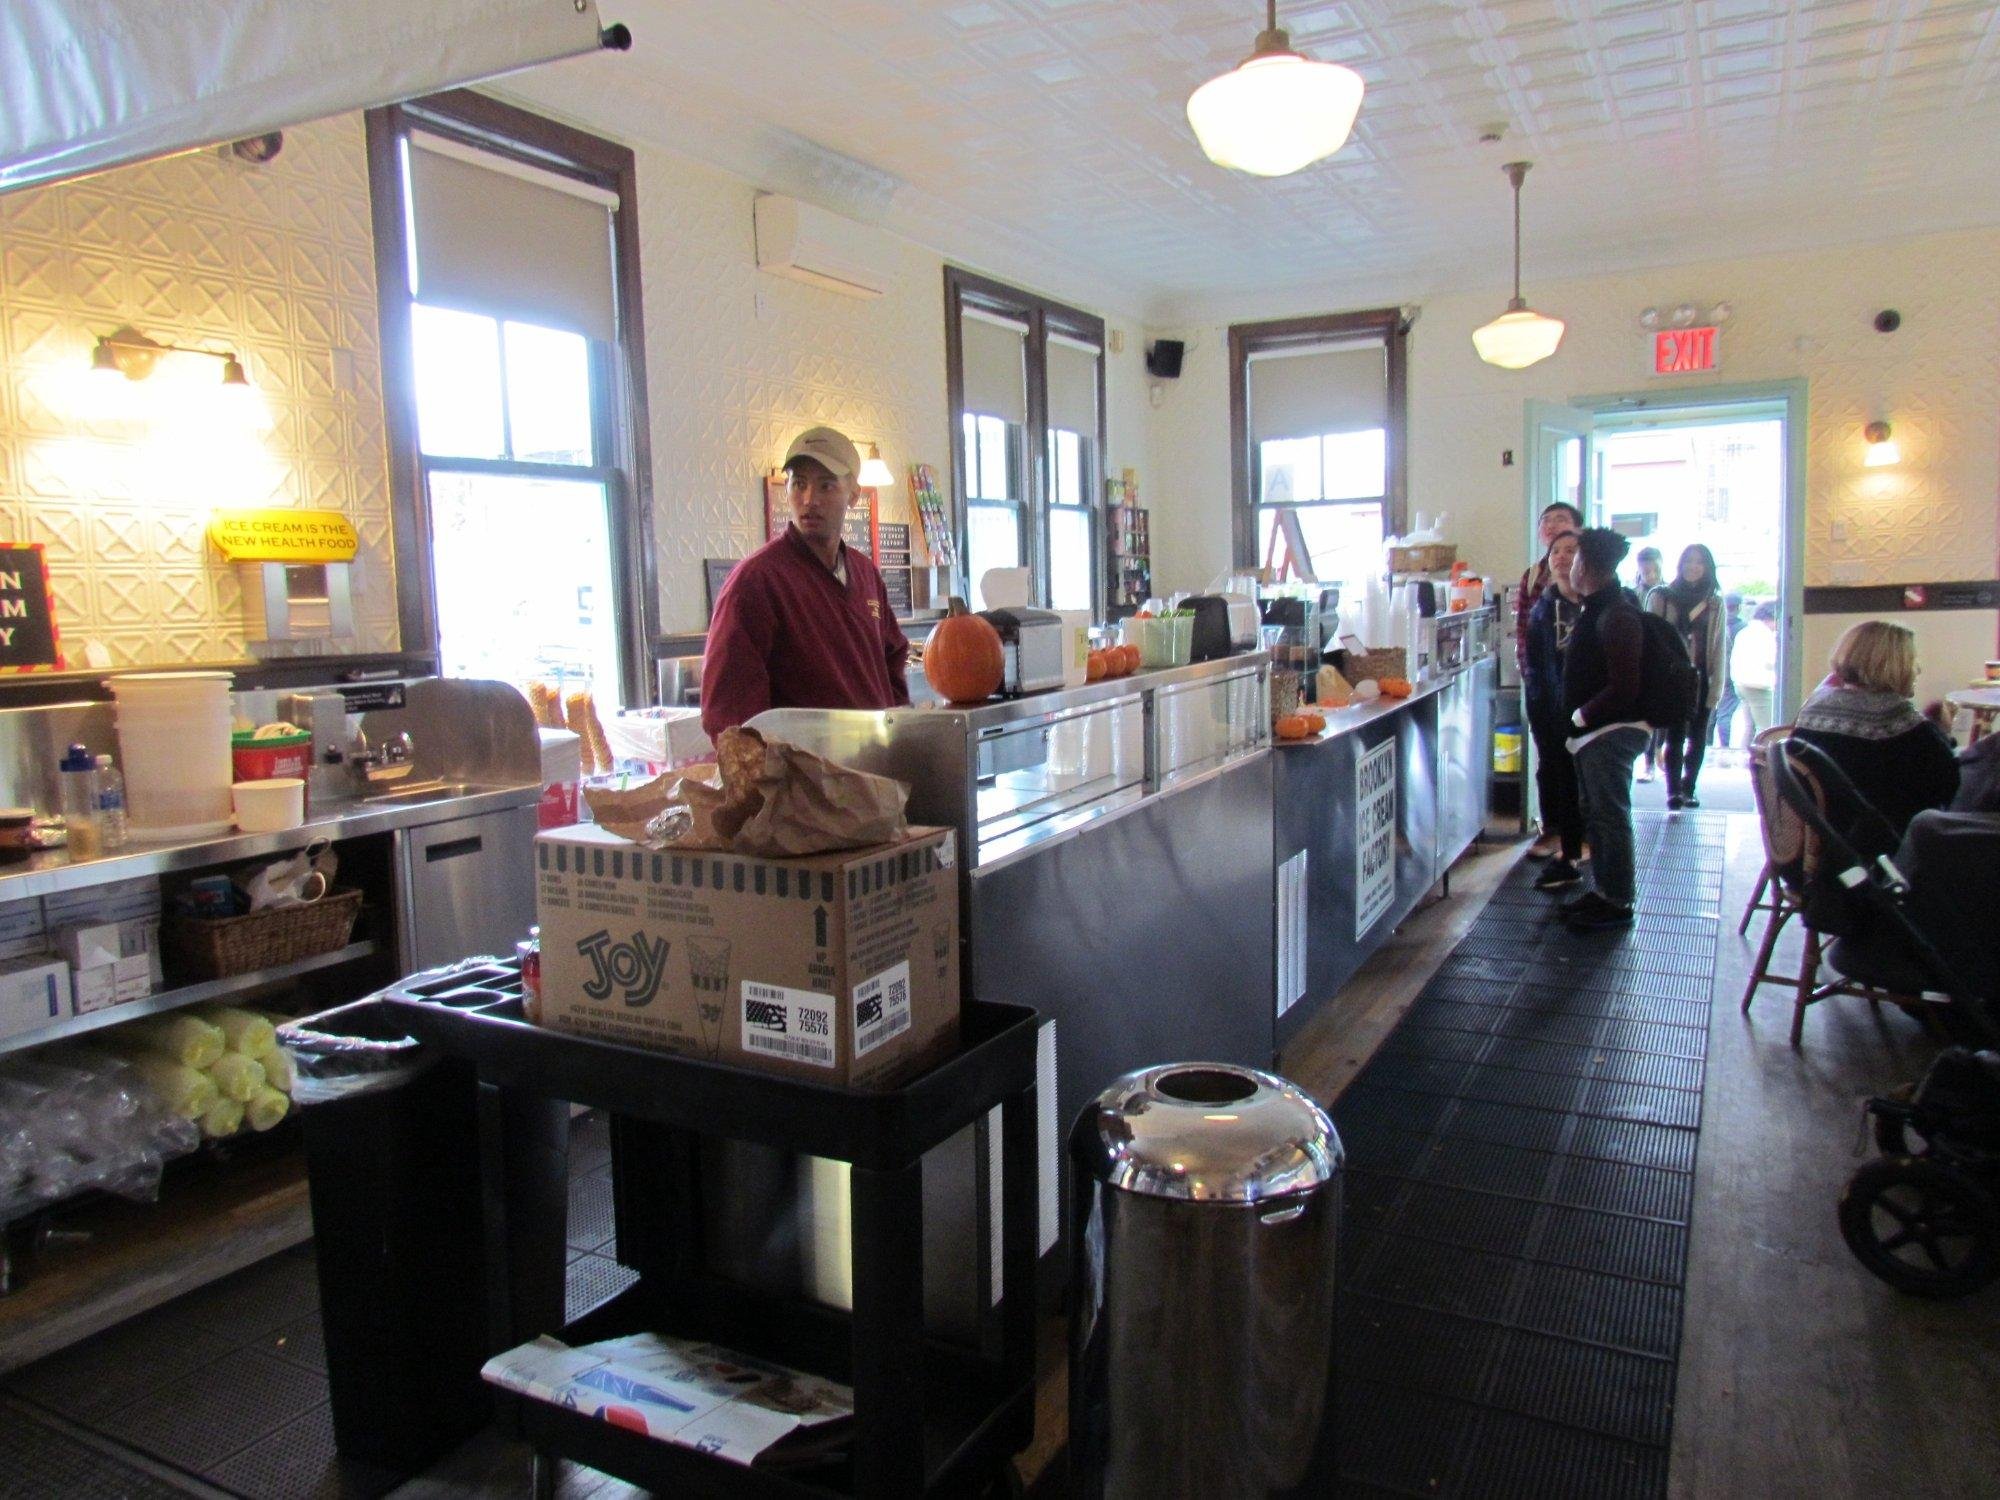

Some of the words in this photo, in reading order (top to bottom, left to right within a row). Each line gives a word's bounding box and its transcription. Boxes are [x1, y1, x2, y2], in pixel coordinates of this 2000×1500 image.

[1656, 327, 1716, 374] EXIT
[223, 520, 249, 531] ICE
[252, 522, 303, 533] CREAM
[306, 524, 318, 534] IS
[322, 524, 349, 534] THE
[222, 536, 257, 545] NEW
[260, 537, 316, 548] HEALTH
[319, 539, 356, 549] FOOD
[1359, 749, 1393, 802] BROOKLYN
[798, 1007, 828, 1023] 72092
[799, 1020, 829, 1036] 75576
